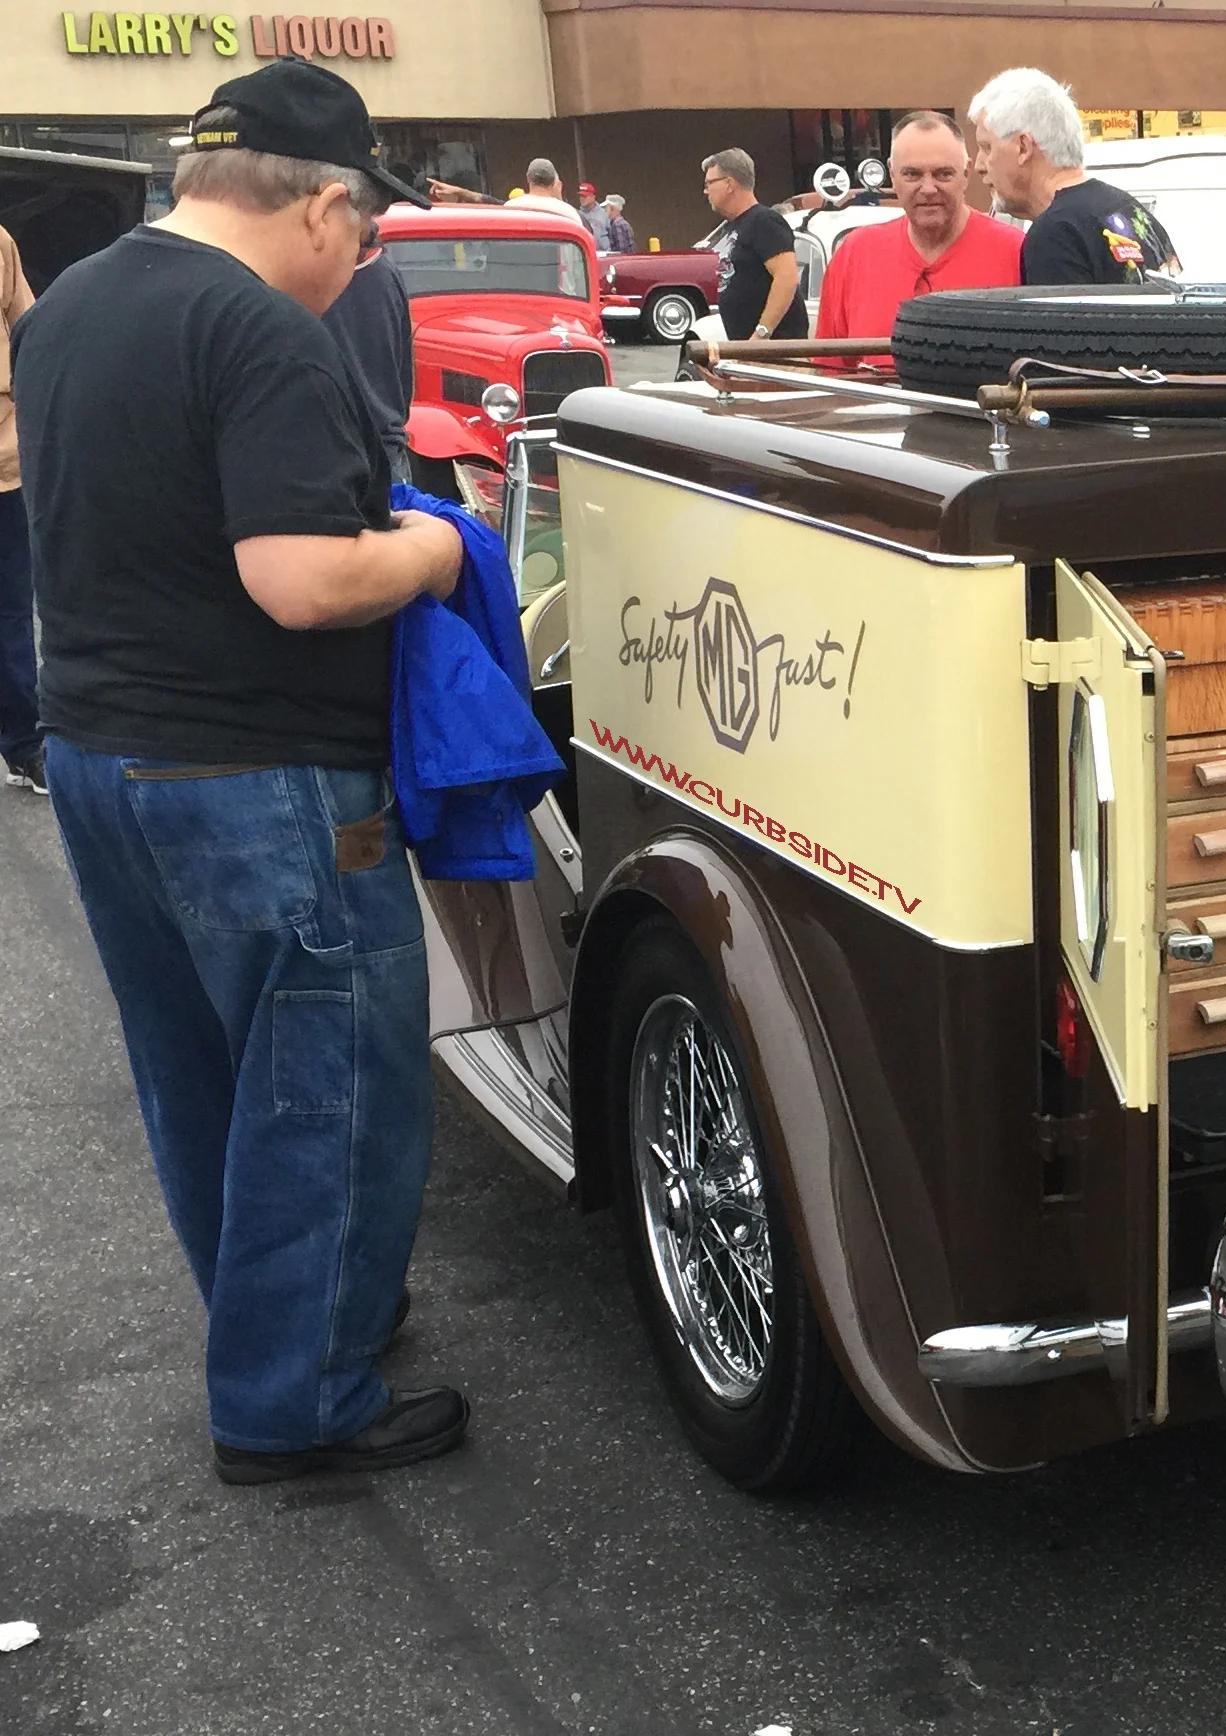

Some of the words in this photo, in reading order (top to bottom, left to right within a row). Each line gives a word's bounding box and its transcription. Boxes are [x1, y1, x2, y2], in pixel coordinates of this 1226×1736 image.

[61, 12, 239, 56] LARRY'S
[250, 14, 396, 61] LIQUOR
[619, 596, 698, 709] Safety
